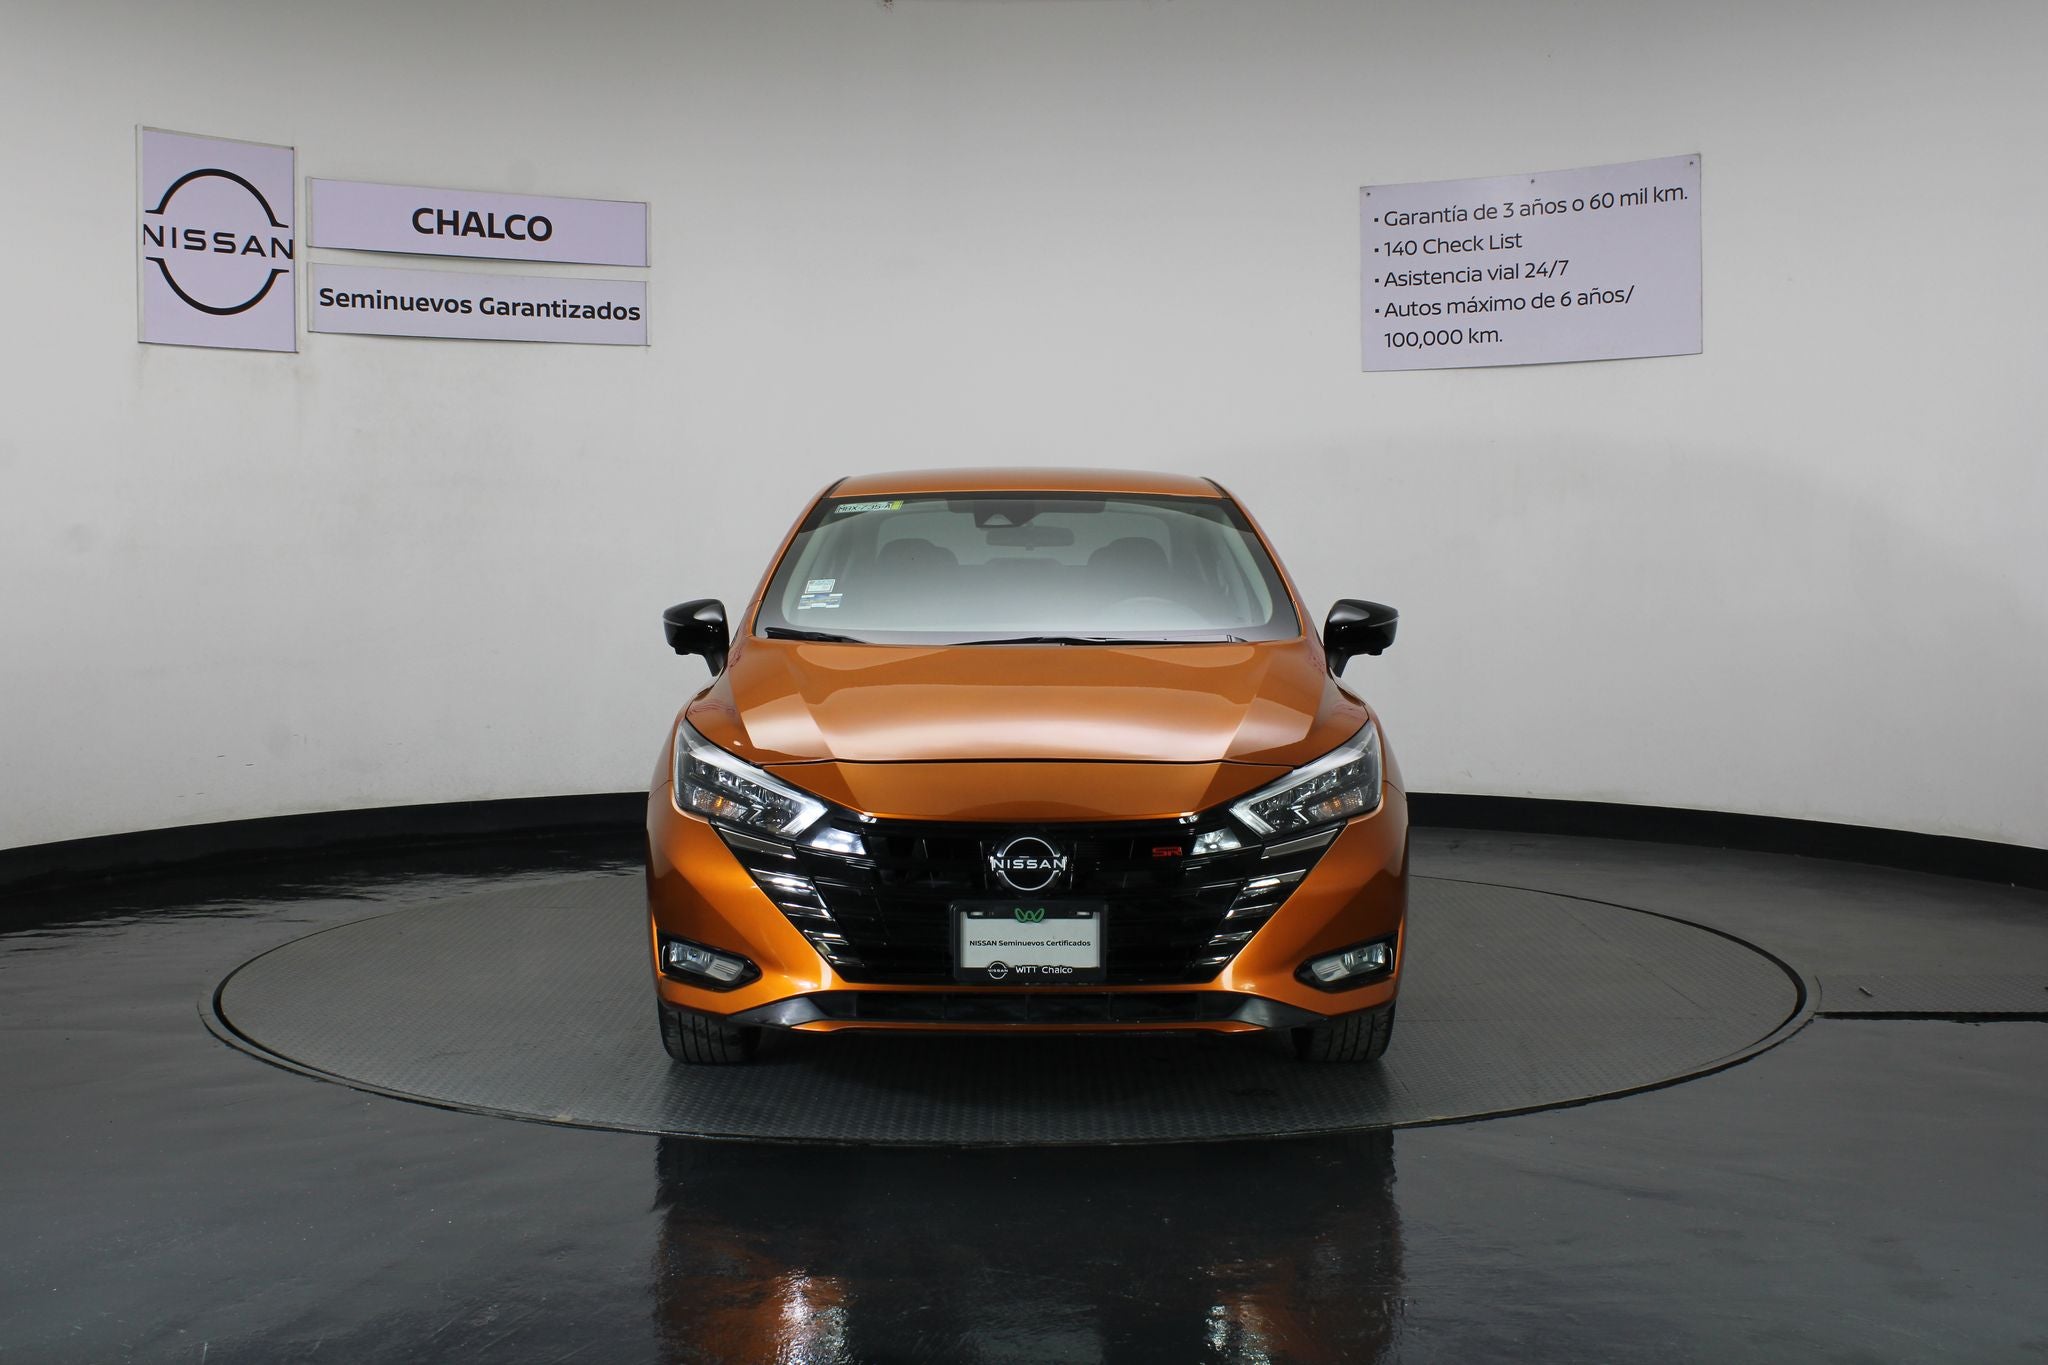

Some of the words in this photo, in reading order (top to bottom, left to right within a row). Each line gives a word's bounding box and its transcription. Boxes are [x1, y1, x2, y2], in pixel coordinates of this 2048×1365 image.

[1383, 204, 1468, 227] Garantía
[1473, 203, 1498, 221] de
[1502, 202, 1514, 219] 3
[1519, 198, 1568, 217] años
[1571, 198, 1585, 212] o
[1589, 192, 1615, 210] 60
[1620, 186, 1648, 207] mil
[1653, 184, 1689, 204] km.
[411, 207, 553, 242] CHALCO
[143, 223, 296, 261] NISSAN
[1383, 239, 1418, 257] 140
[1422, 234, 1485, 255] Check
[1489, 232, 1523, 251] List
[1383, 266, 1483, 288] Asistencia
[1486, 262, 1520, 281] vial
[1524, 259, 1570, 279] 24/7
[319, 287, 473, 315] Seminuevos
[478, 296, 641, 322] Garantizados
[1383, 300, 1442, 318] Autos
[1446, 295, 1527, 315] máximo
[1530, 291, 1556, 310] de
[1560, 290, 1572, 307] 6
[1576, 284, 1635, 306] años/
[1383, 328, 1463, 350] 100,000
[1468, 327, 1504, 344] km.
[991, 857, 1067, 871] NISSAN
[1152, 847, 1183, 857] SR
[969, 939, 998, 947] NISSAN
[998, 939, 1045, 947] Seminuevos
[1045, 939, 1092, 947] Certificados
[1015, 965, 1037, 974] WITT
[1041, 965, 1073, 974] Chalco
